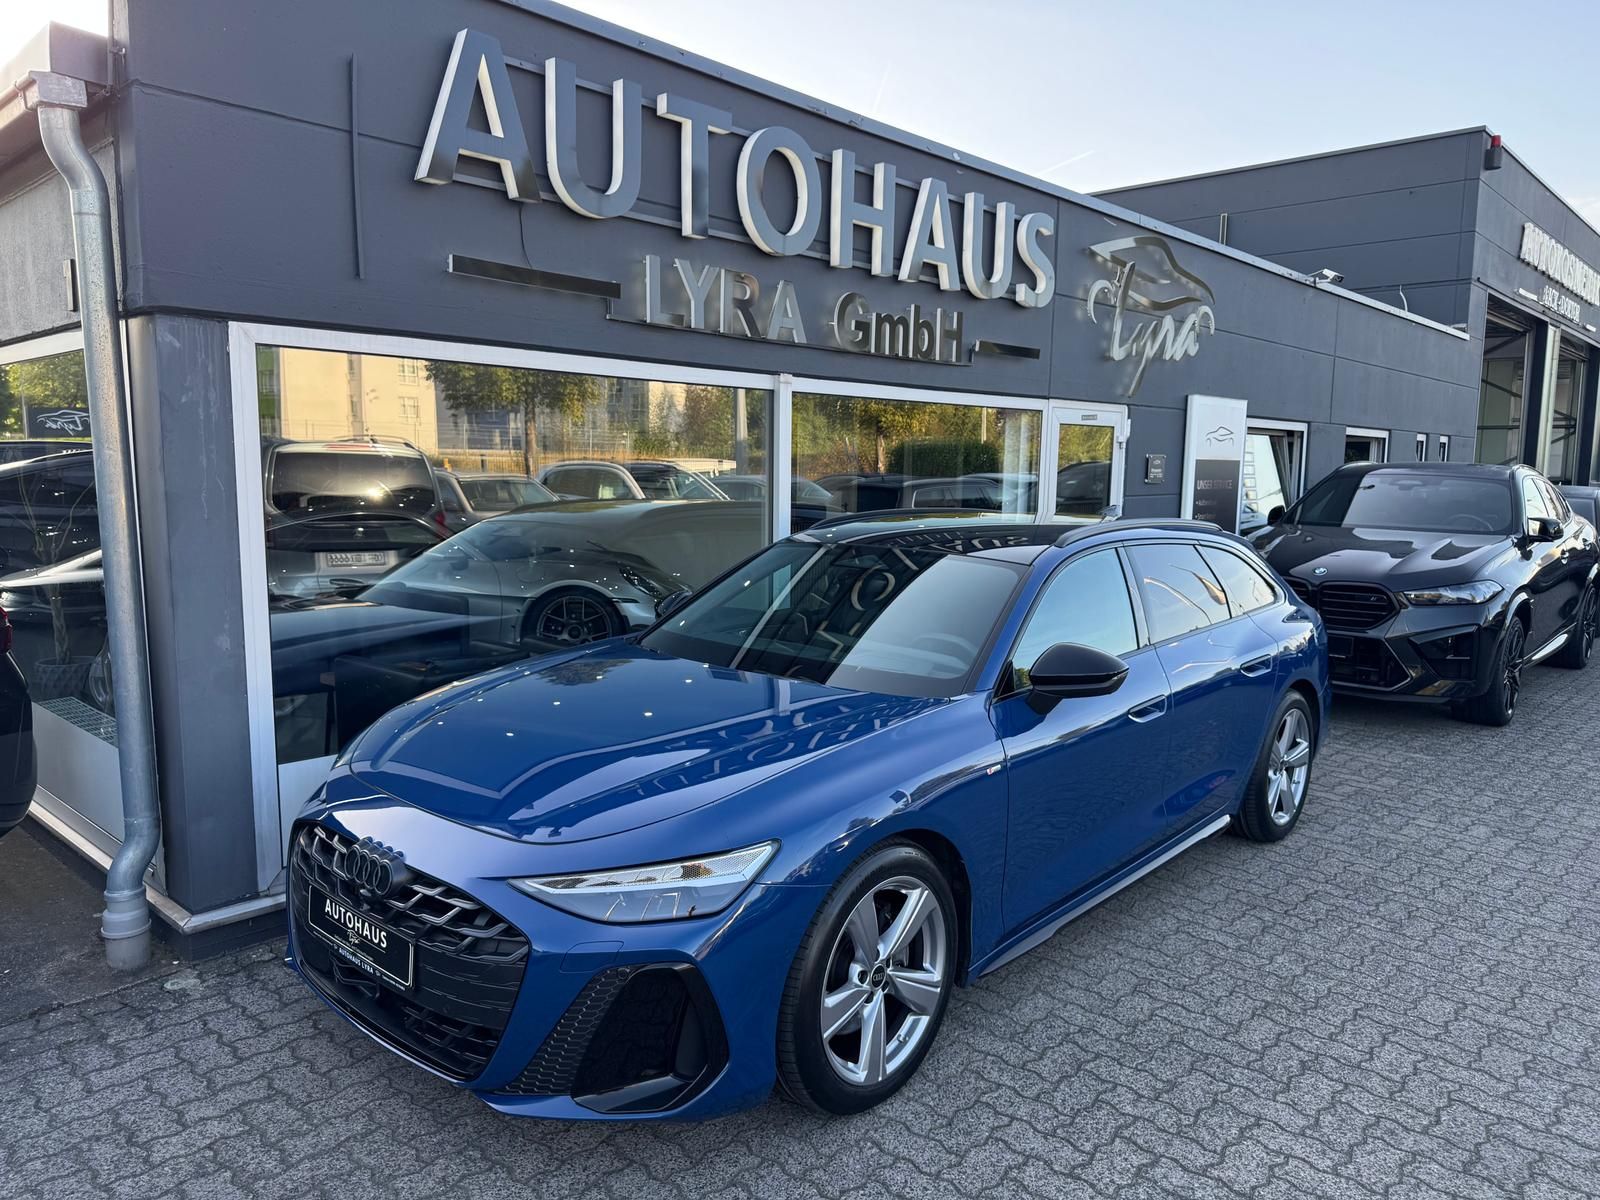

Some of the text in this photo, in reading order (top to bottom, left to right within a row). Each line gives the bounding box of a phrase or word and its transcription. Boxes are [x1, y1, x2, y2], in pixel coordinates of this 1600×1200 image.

[414, 28, 1055, 309] AUTOHAUS
[643, 254, 964, 362] LYRA GmbH
[325, 898, 387, 948] AUTOHAUS
[338, 947, 361, 966] AUTOHAUS
[361, 961, 374, 975] LYRA
